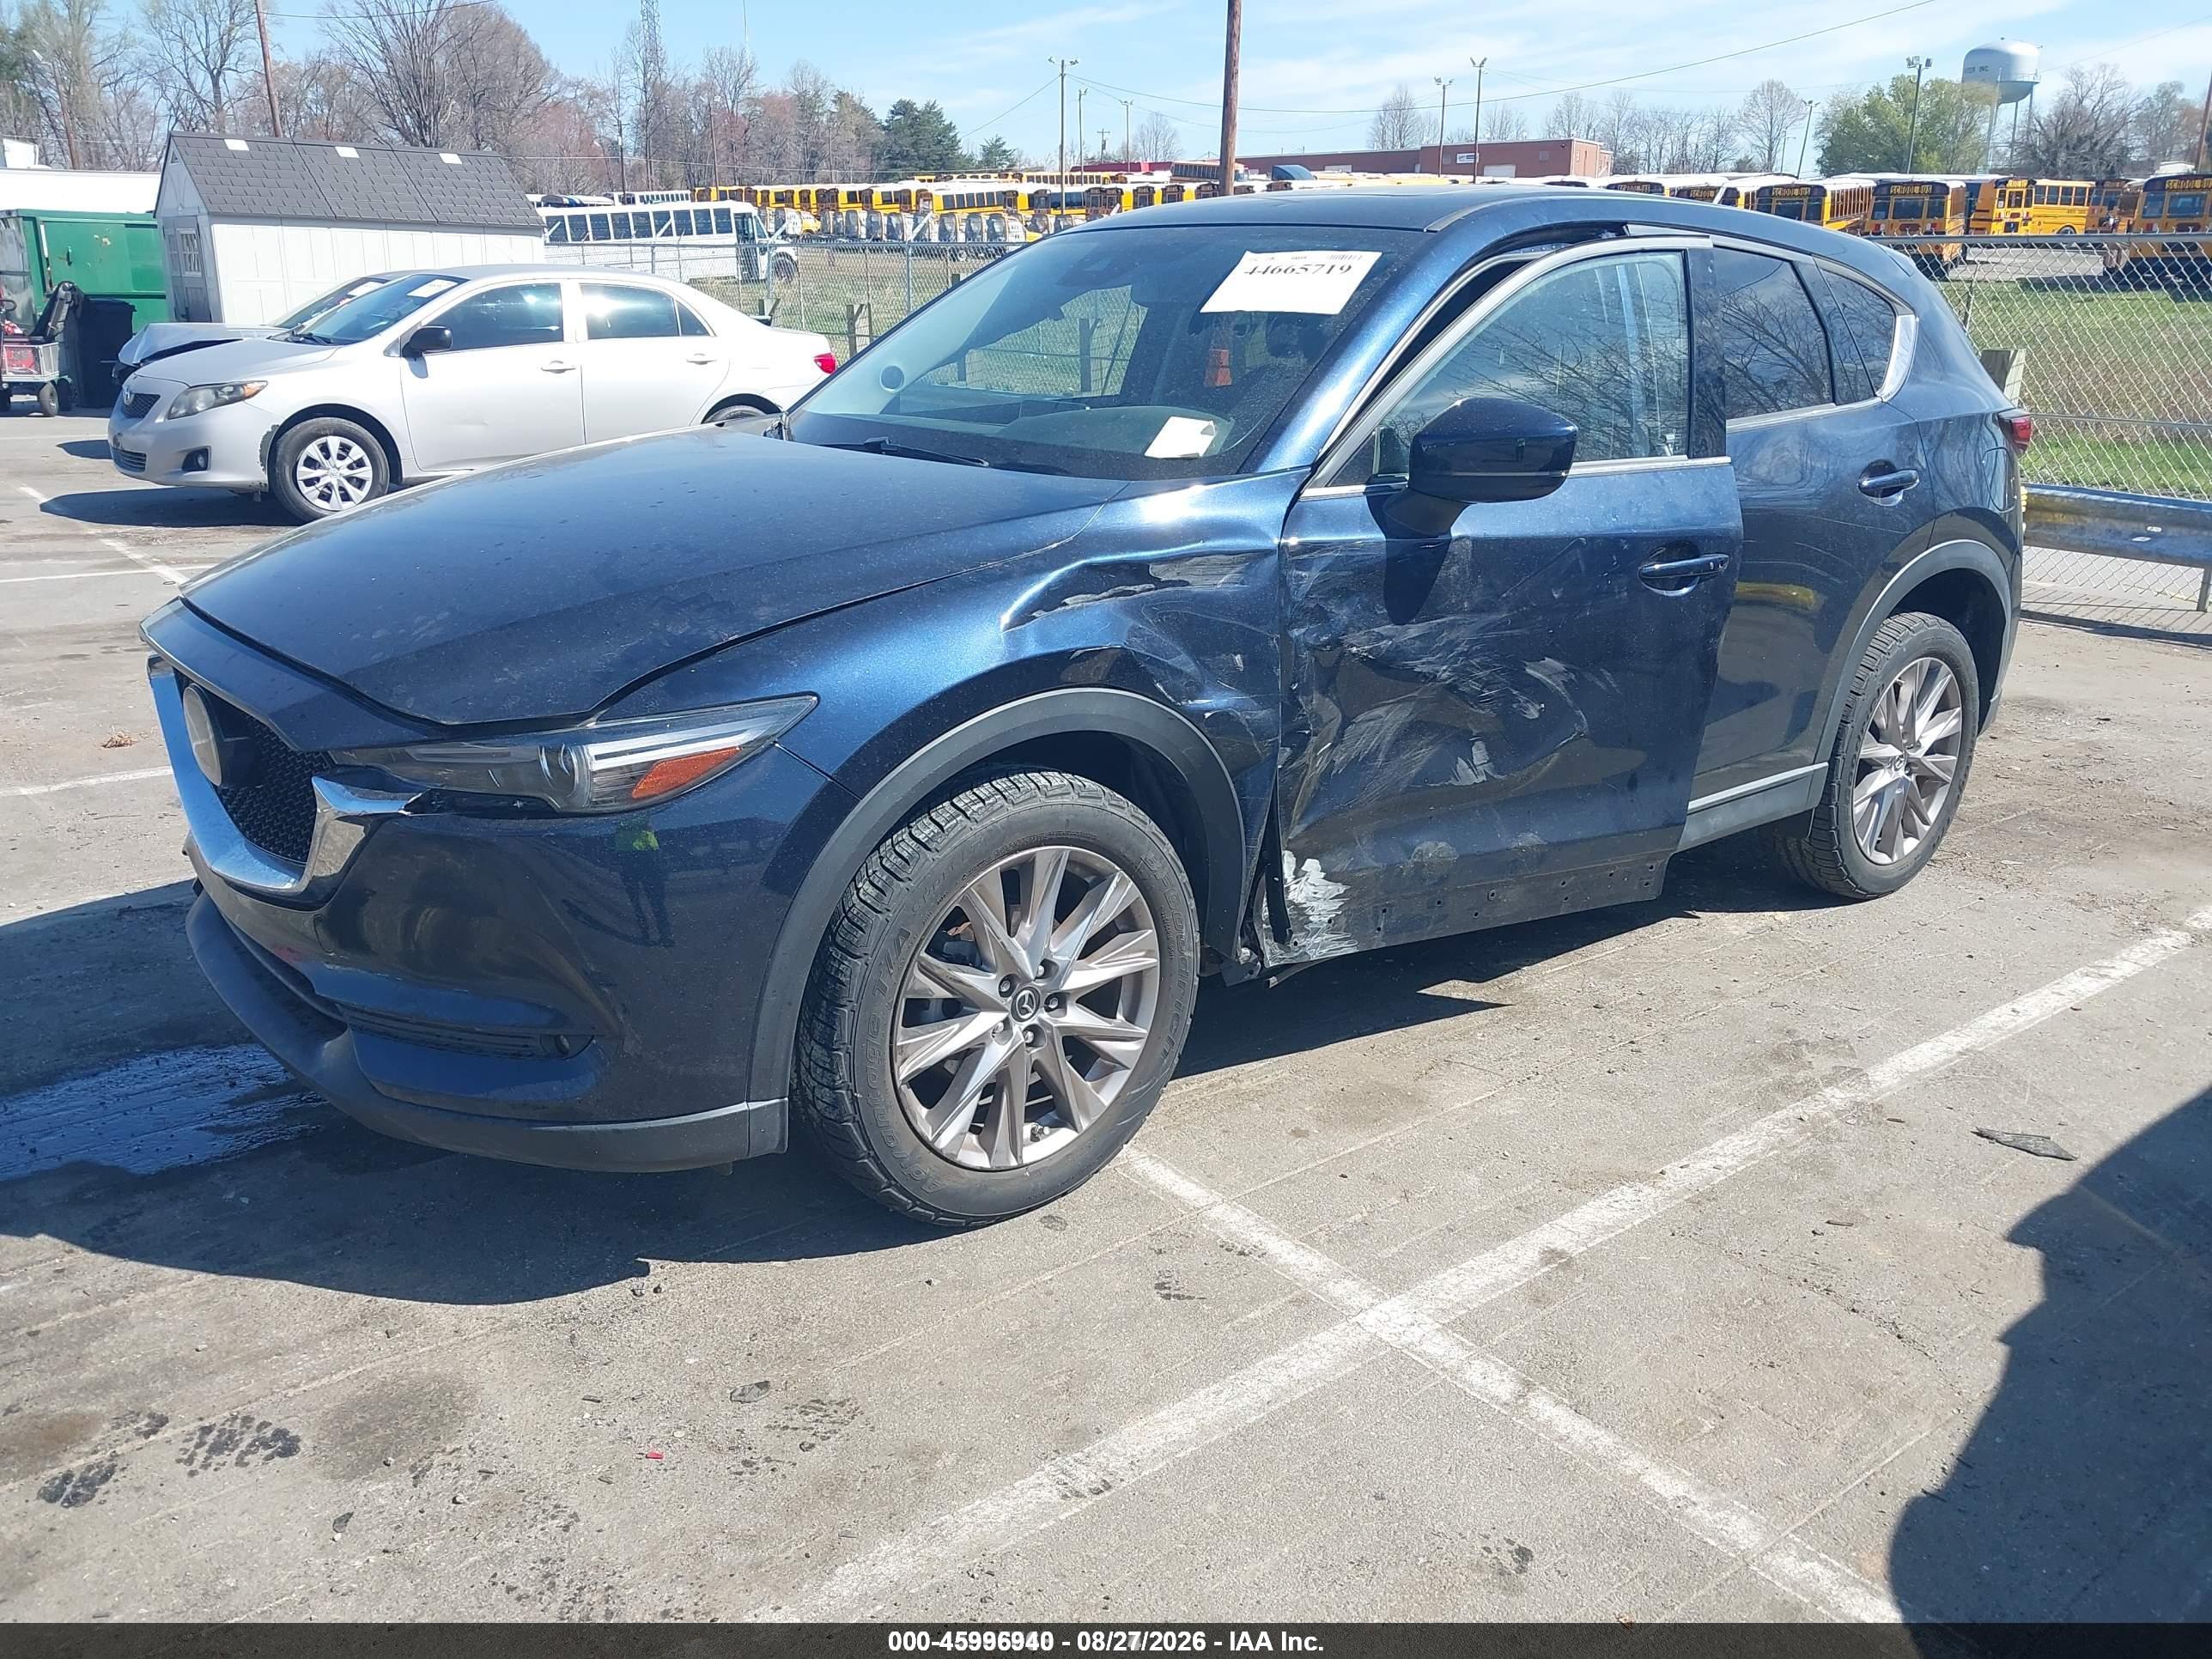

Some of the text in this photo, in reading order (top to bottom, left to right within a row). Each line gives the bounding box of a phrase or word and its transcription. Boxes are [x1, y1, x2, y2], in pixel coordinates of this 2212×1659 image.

[2166, 179, 2212, 189] SCHOOL BU
[1772, 187, 1810, 197] SCHOOL BUS
[1890, 185, 1932, 195] SCHOOL BUS
[1244, 264, 1352, 276] 44665719
[872, 927, 911, 997] T/A
